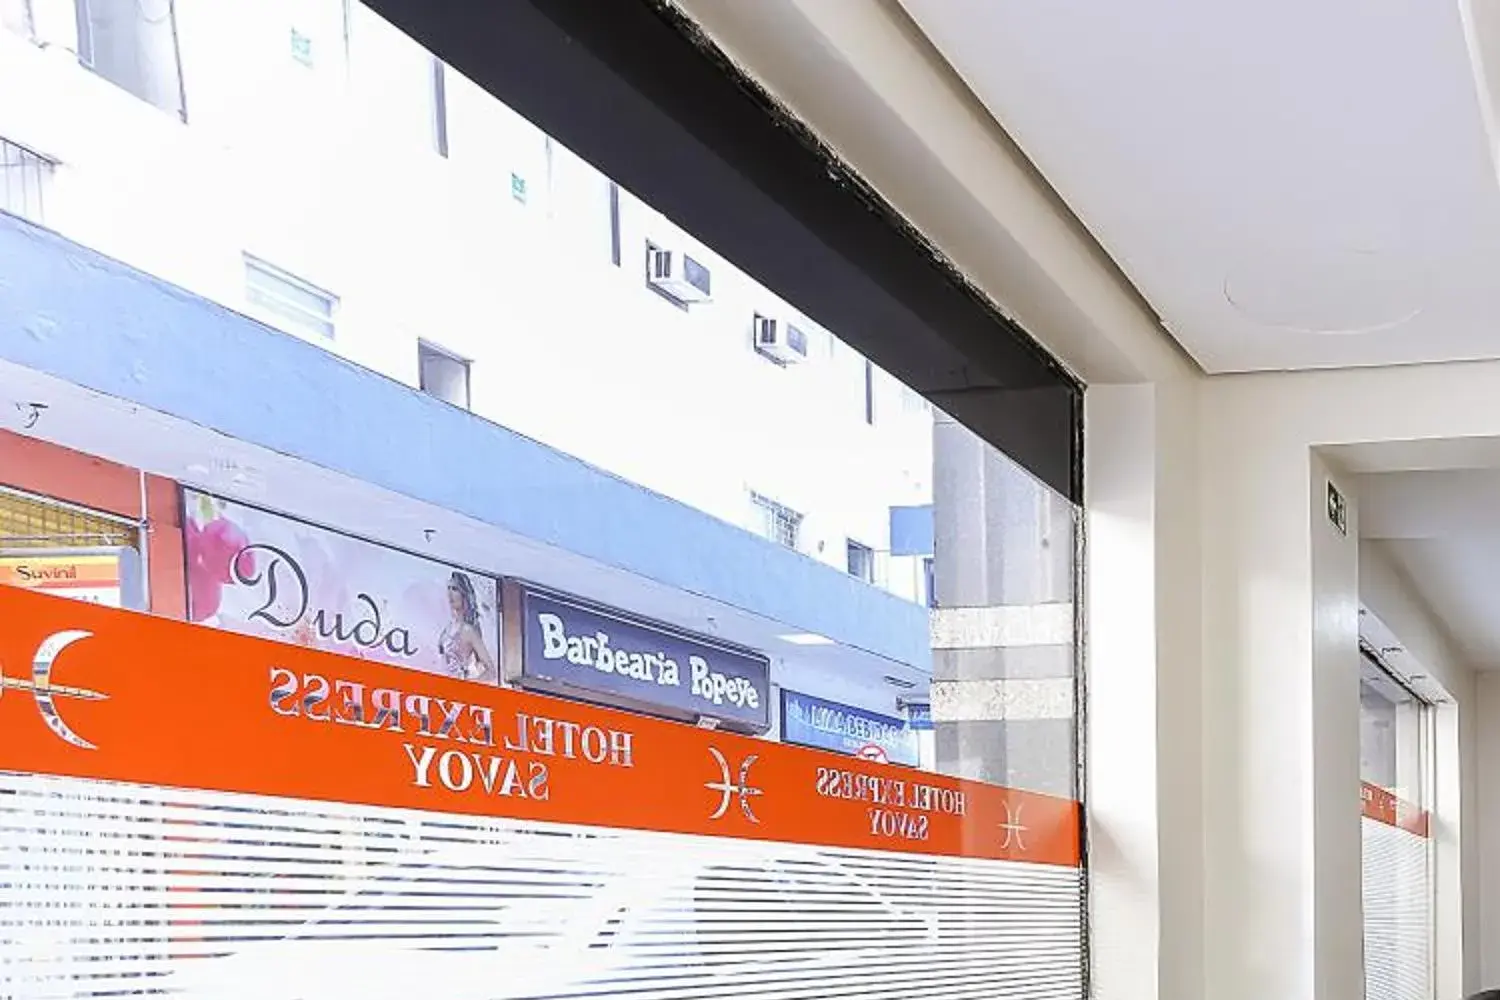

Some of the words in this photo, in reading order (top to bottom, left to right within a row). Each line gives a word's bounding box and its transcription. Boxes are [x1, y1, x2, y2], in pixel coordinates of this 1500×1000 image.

[16, 565, 76, 580] Suvinil
[231, 543, 418, 657] Duda
[539, 613, 680, 687] Barbearia
[691, 656, 759, 709] Popeye
